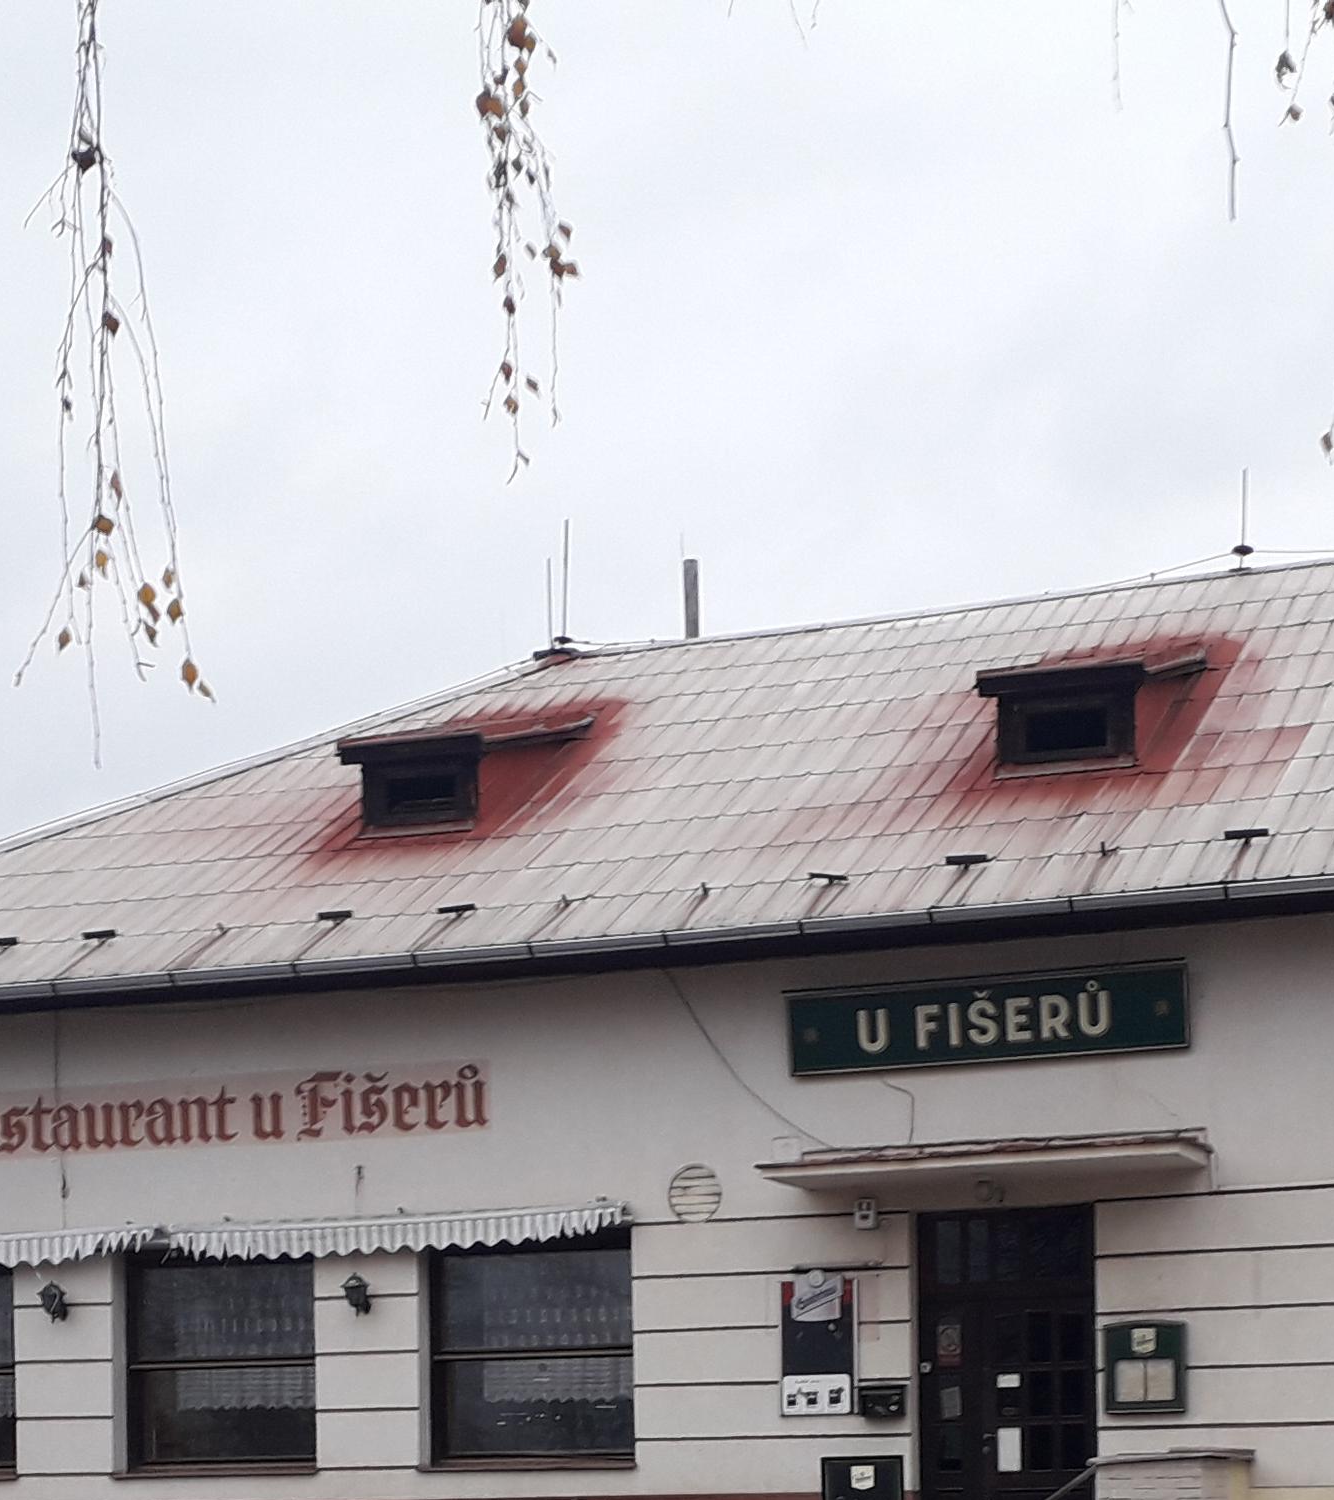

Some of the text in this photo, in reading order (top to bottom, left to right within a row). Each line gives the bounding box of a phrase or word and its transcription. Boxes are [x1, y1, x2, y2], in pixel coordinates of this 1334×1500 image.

[855, 980, 1113, 1054] U FIŠERŮ
[249, 1093, 287, 1140] u
[294, 1064, 490, 1142] Fišerů
